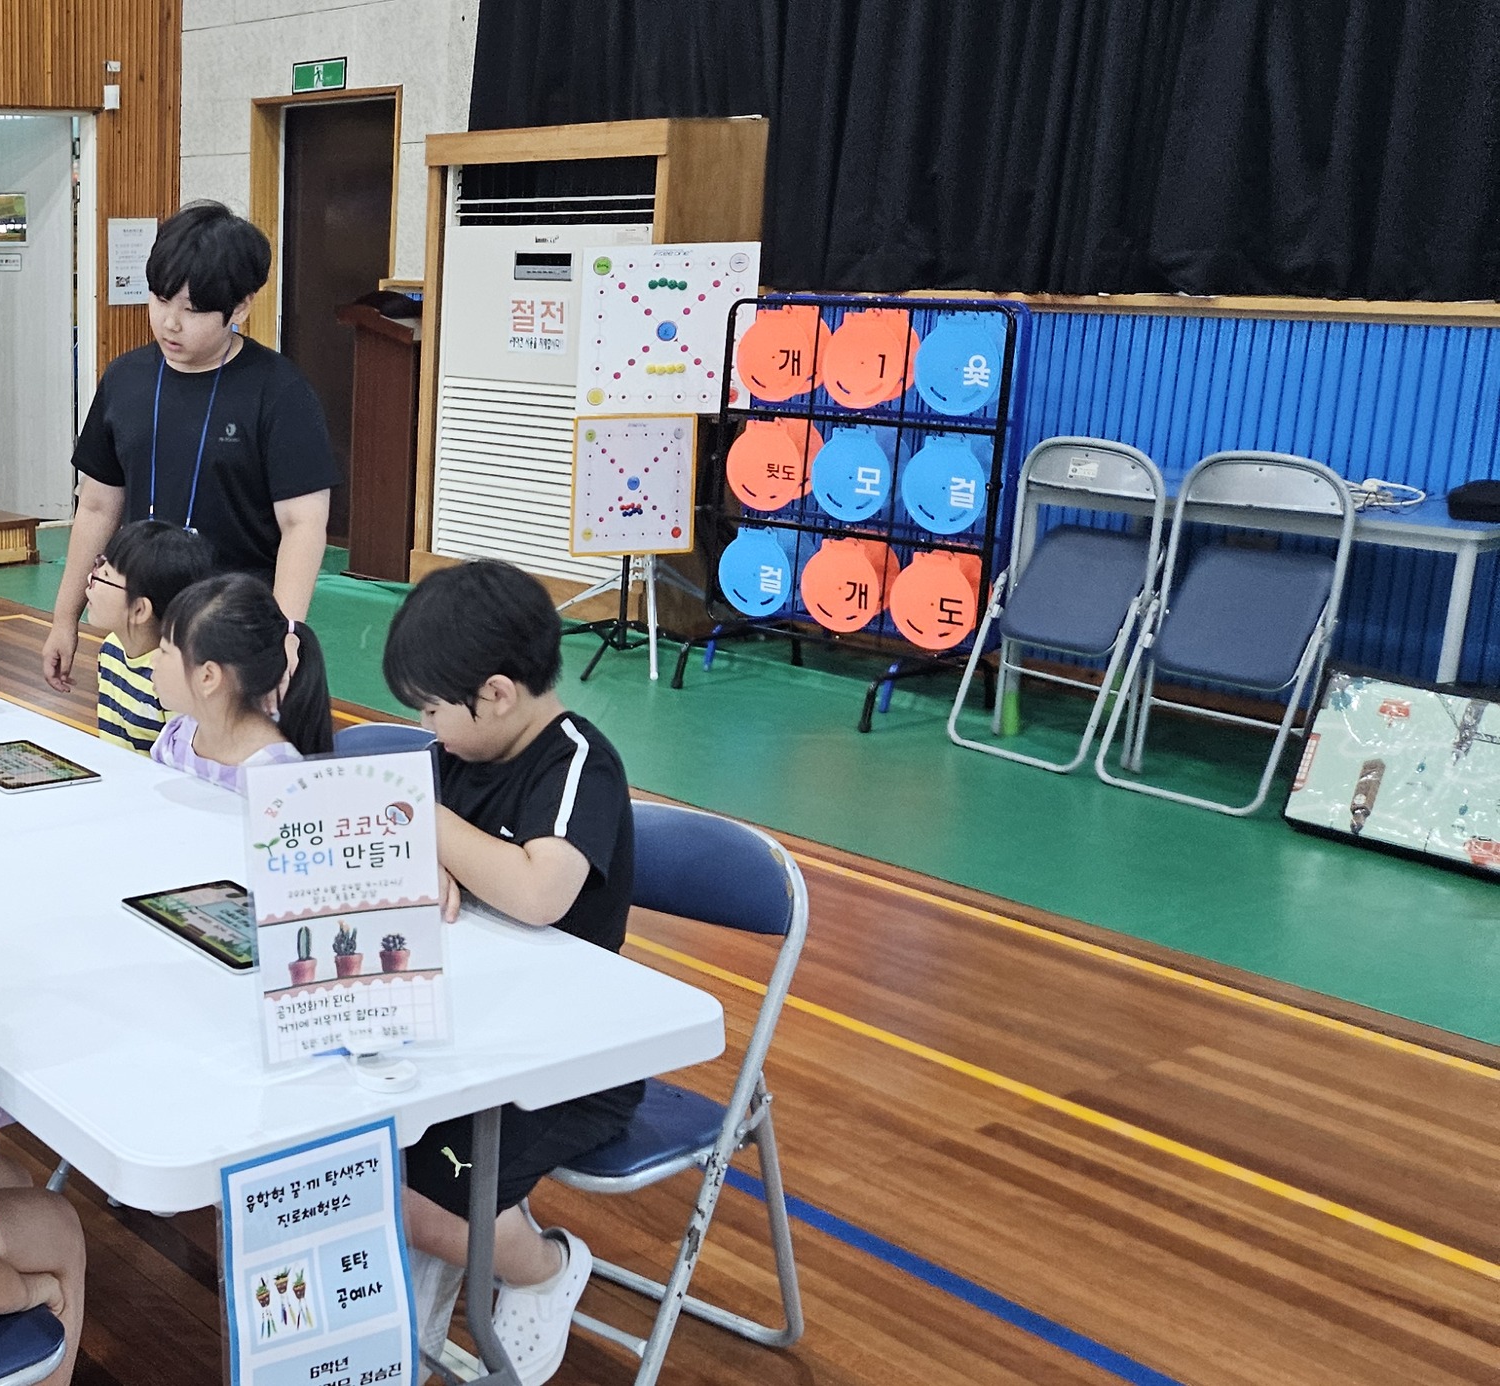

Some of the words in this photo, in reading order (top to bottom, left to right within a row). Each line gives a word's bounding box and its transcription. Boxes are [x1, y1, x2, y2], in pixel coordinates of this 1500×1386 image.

[511, 299, 564, 334] 절전
[778, 349, 801, 377] 개
[963, 354, 991, 388] 윷
[767, 463, 796, 481] 뒷도
[855, 466, 882, 496] 모
[950, 476, 976, 510] 걸
[759, 564, 783, 595] 걸
[845, 580, 869, 610] 개
[937, 596, 964, 627] 도
[279, 820, 323, 849] 행잉
[334, 812, 397, 838] 코코넛
[268, 848, 333, 875] 다육이
[343, 841, 410, 869] 만들기
[276, 997, 329, 1020] 공기정화가
[332, 992, 356, 1008] 된다
[278, 1019, 309, 1034] 거기에
[356, 1006, 398, 1022] 쉽다고?
[277, 1194, 351, 1228] 진로체험부스
[341, 1250, 369, 1273] 토탈
[336, 1281, 383, 1309] 공예사
[309, 1355, 349, 1380] 6학년
